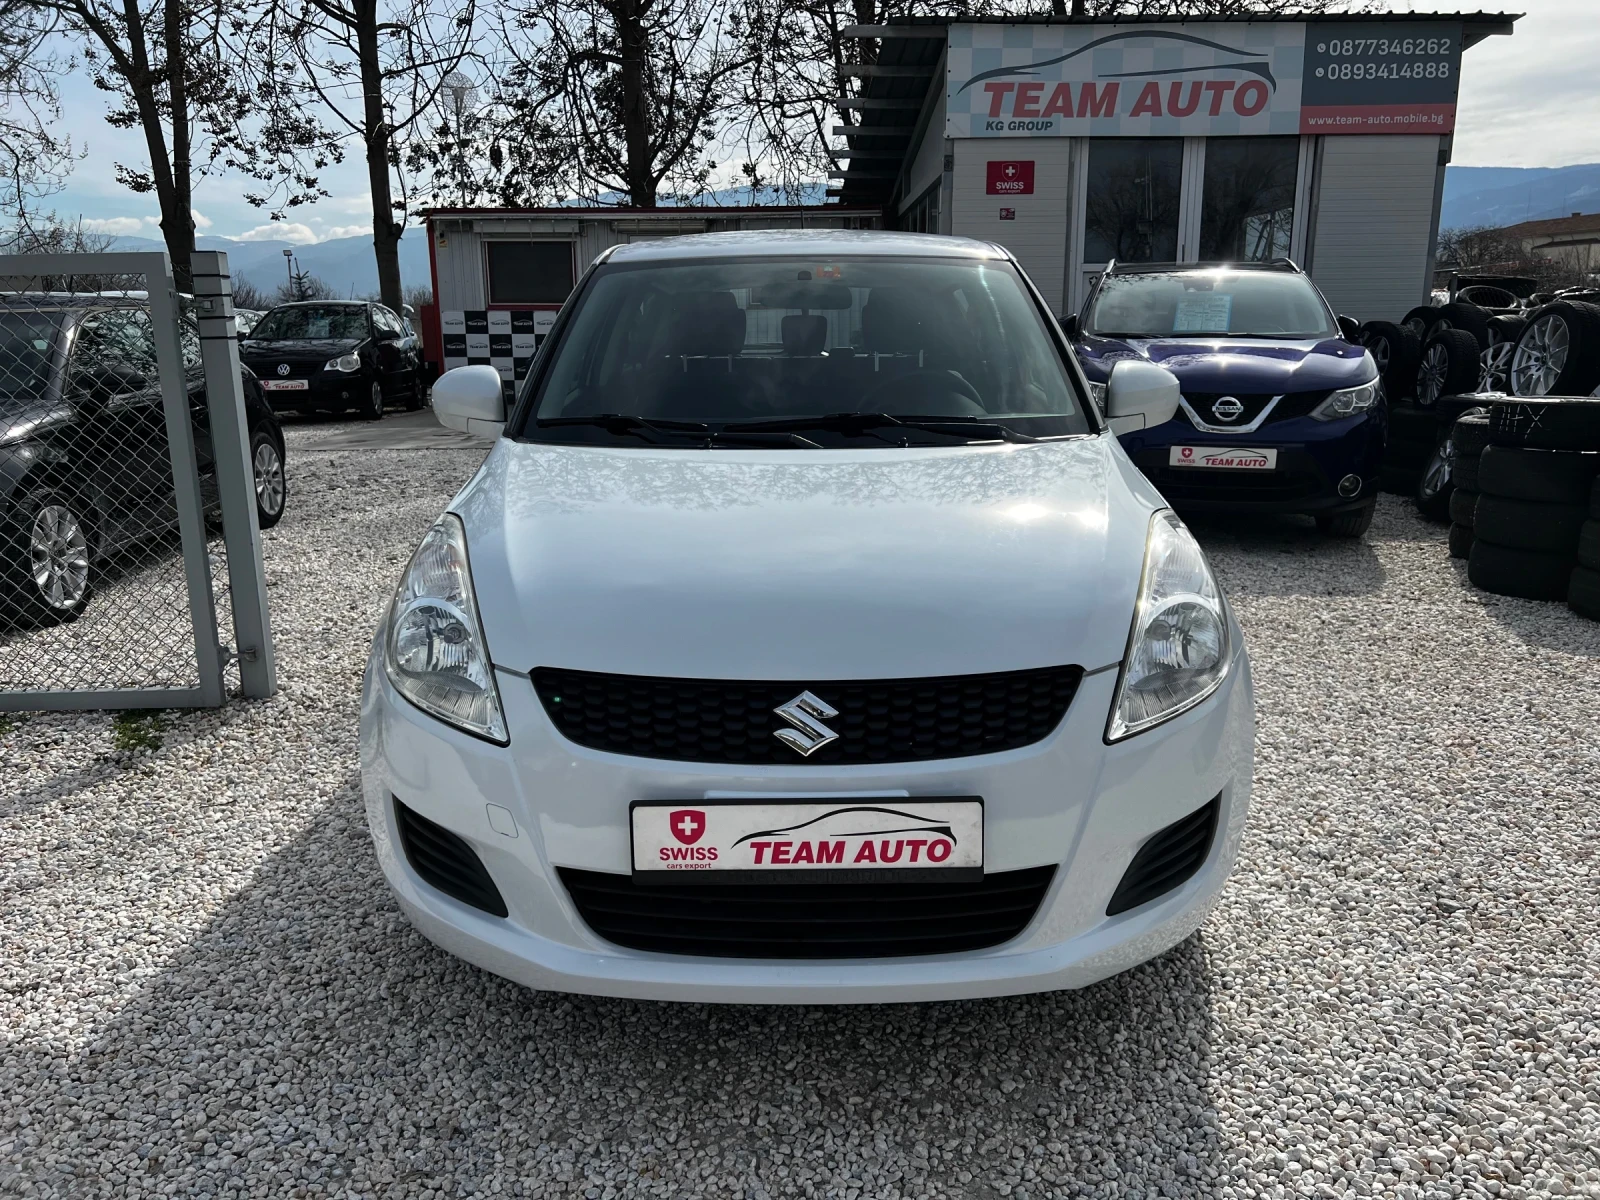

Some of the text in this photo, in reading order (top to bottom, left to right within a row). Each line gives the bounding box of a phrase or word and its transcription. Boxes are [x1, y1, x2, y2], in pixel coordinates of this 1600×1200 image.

[1329, 38, 1450, 56] 0877346262
[1327, 62, 1449, 80] 0893414888
[983, 80, 1269, 118] TEAM AUTO
[985, 120, 1053, 131] KG GROUP
[1308, 113, 1444, 125] www.team-auto.mobile.bg
[996, 181, 1024, 190] SWISS
[1205, 458, 1266, 467] TEAM AUTO
[659, 847, 718, 861] SWISS
[750, 839, 953, 864] TEAM AUTO
[684, 862, 712, 870] export
